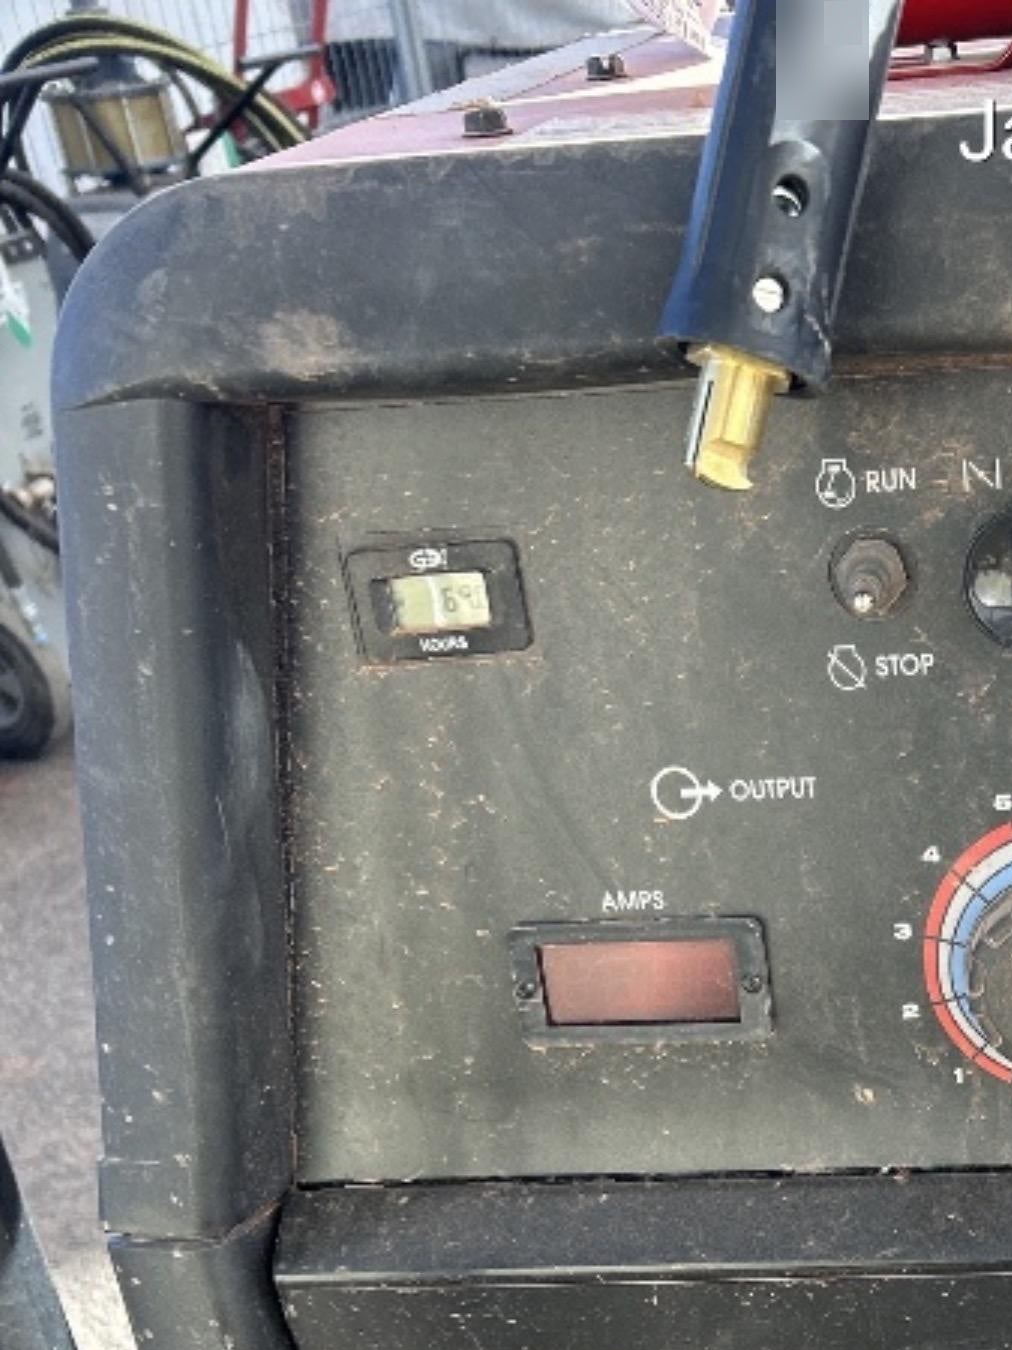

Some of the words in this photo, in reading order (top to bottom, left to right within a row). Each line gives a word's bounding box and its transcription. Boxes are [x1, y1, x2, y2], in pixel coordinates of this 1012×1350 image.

[866, 468, 917, 493] RUN
[875, 649, 934, 677] STOP
[729, 776, 817, 801] OUTPUT
[993, 795, 1012, 811] 5
[921, 845, 941, 863] 4
[602, 890, 664, 911] AMPS
[893, 925, 913, 940] 3
[902, 1004, 921, 1019] 2
[953, 1068, 965, 1083] 1
